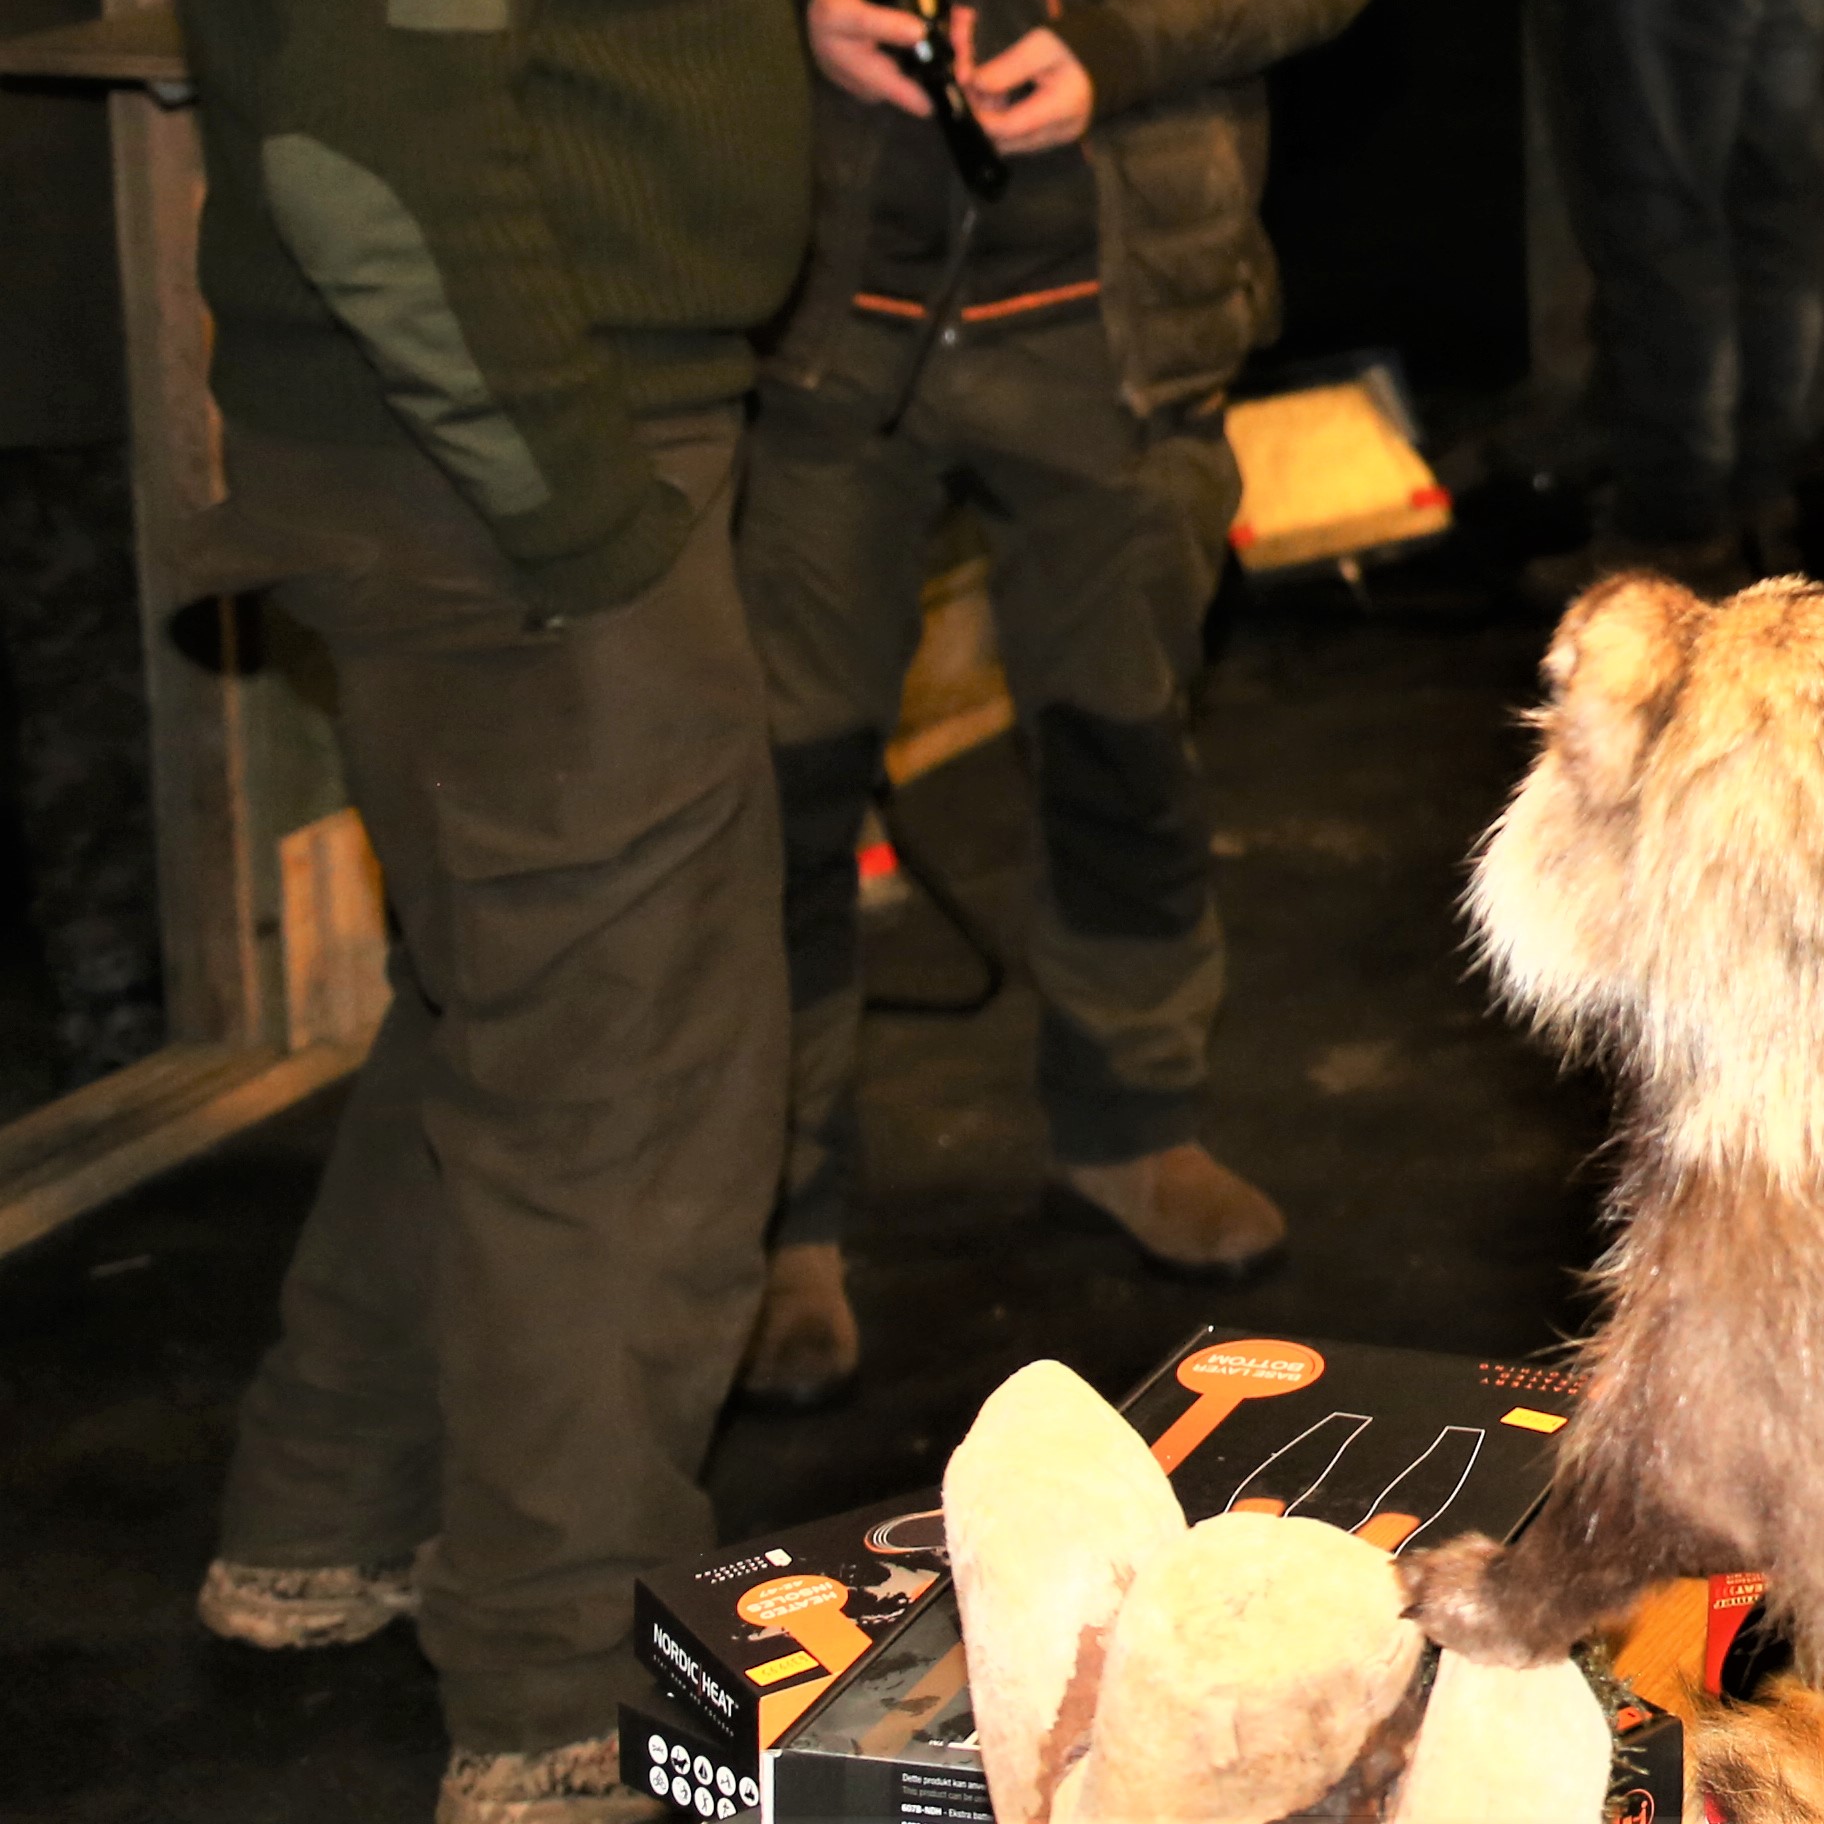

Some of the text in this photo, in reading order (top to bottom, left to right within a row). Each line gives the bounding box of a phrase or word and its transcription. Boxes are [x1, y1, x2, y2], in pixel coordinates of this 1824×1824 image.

[1192, 1363, 1303, 1382] BASE LAYER
[1207, 1354, 1306, 1372] BOTTOM
[746, 1581, 833, 1613] INSOLES
[760, 1591, 837, 1620] HEATED
[653, 1623, 698, 1685] NORDIC
[923, 1776, 952, 1787] produkt
